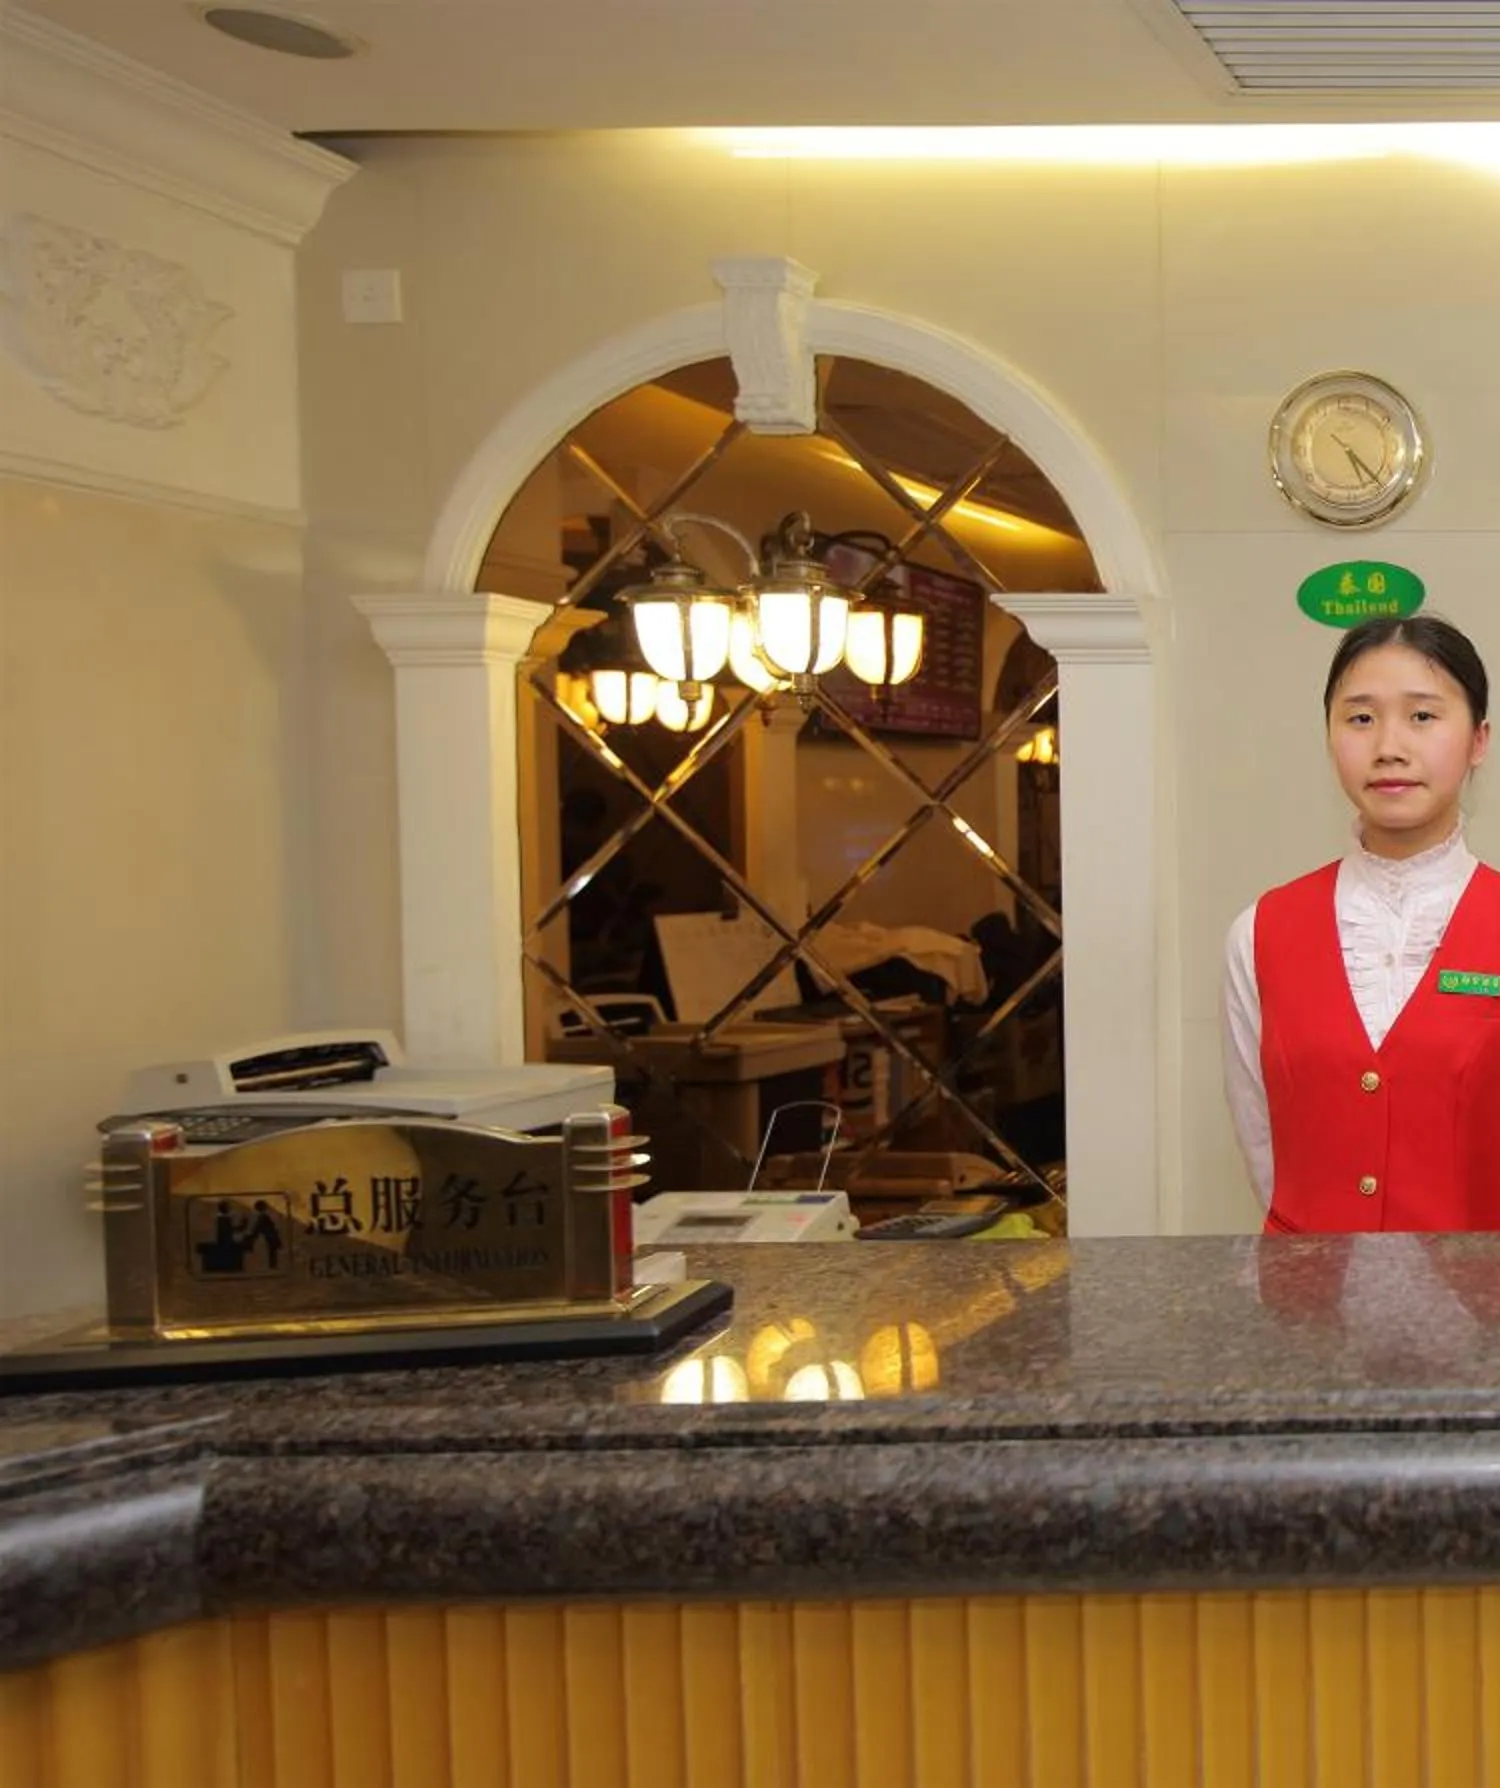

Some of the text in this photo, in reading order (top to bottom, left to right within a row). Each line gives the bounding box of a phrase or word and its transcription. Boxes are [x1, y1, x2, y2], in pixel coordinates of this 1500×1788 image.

[304, 1169, 549, 1235] 总服务台
[309, 1251, 403, 1279] GENERAL
